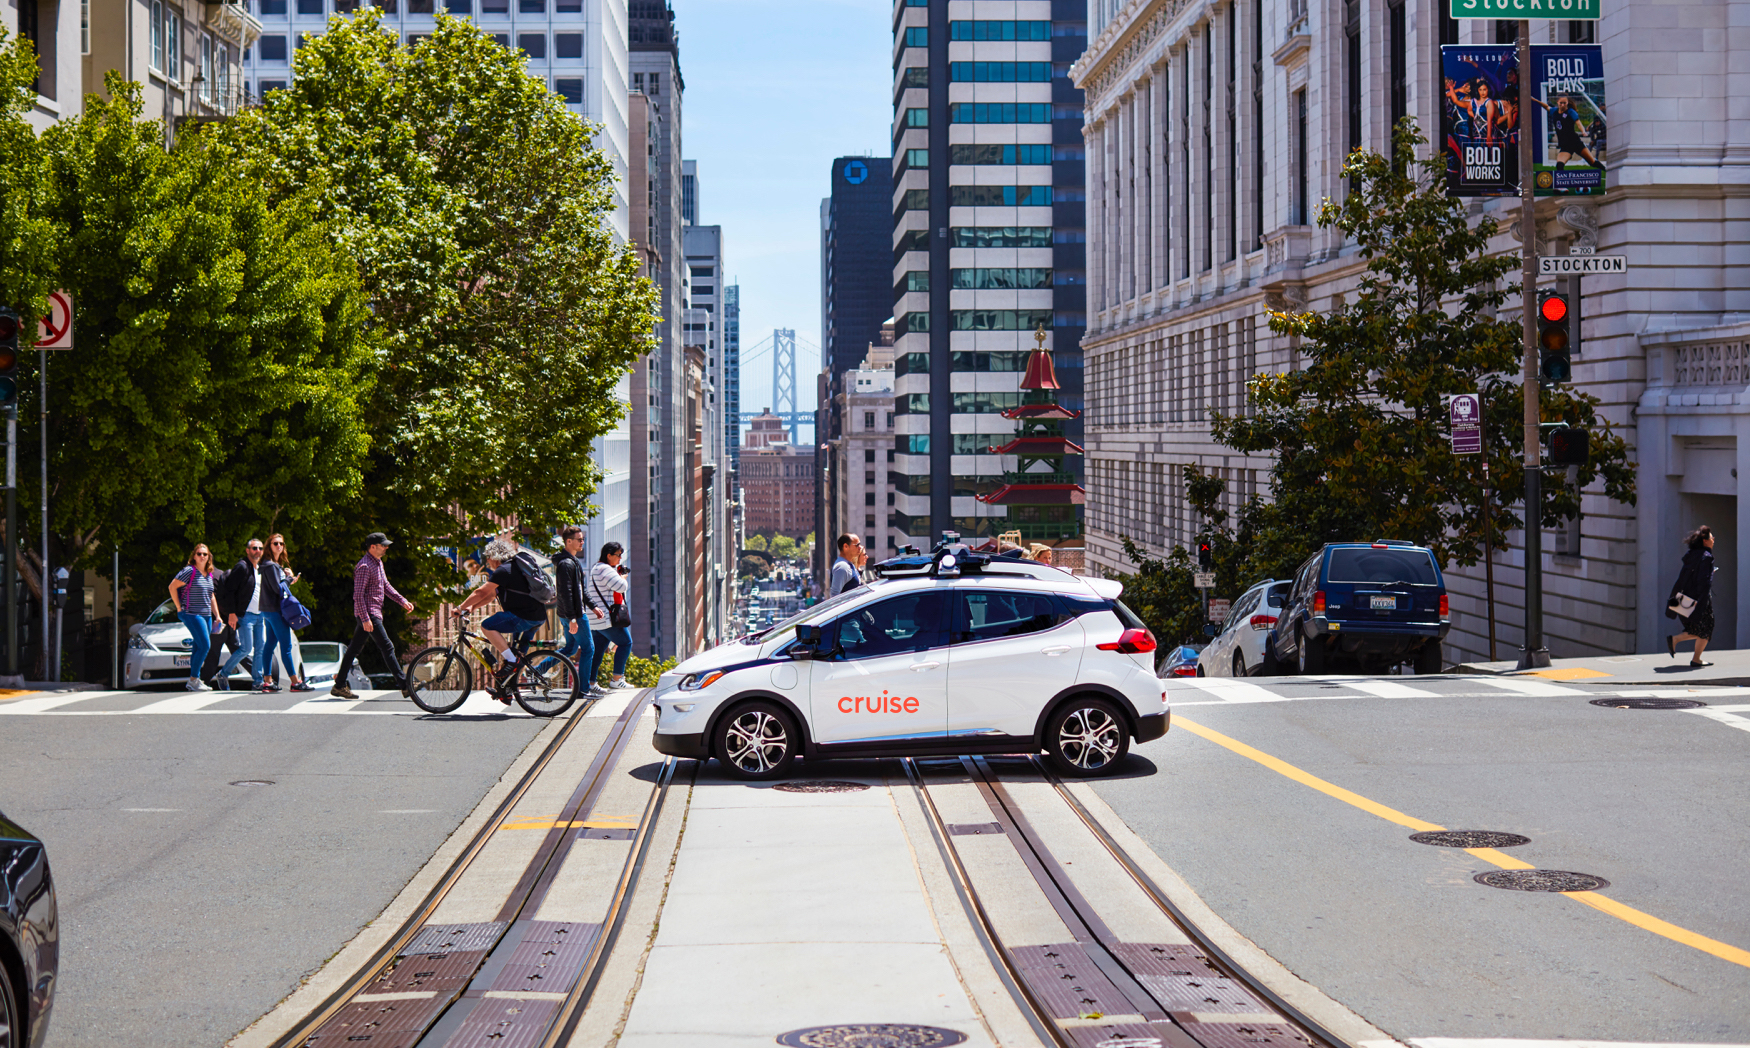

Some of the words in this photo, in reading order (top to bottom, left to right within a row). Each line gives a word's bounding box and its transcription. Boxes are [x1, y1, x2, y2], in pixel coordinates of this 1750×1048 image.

[1463, 0, 1590, 9] Stockton
[1547, 58, 1585, 76] BOLD
[1548, 77, 1586, 93] PLAYS
[1466, 146, 1501, 165] BOLD
[1466, 166, 1501, 179] WORKS
[1543, 258, 1622, 271] STOCKTON
[838, 689, 920, 714] cruise
